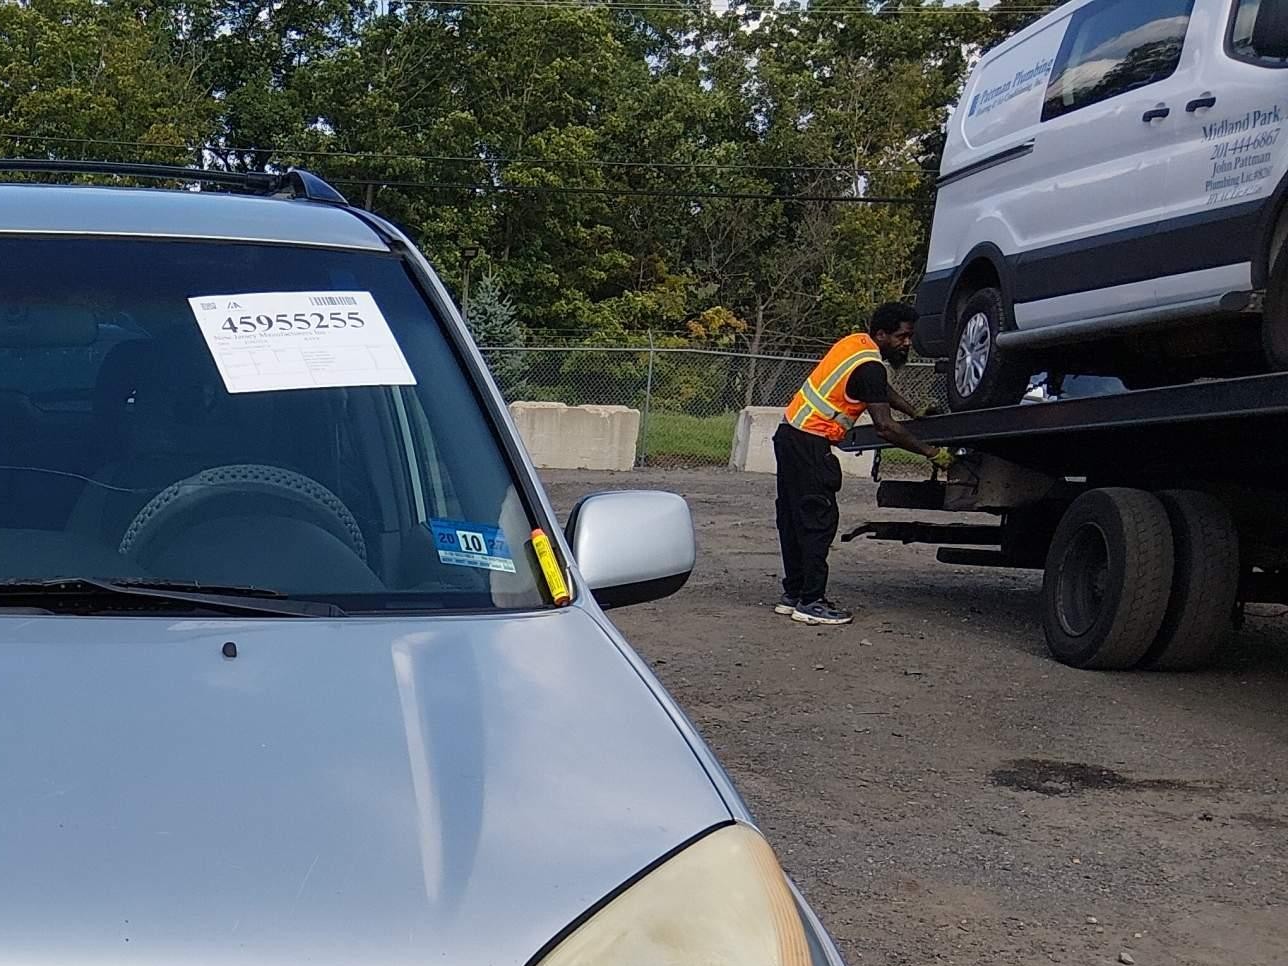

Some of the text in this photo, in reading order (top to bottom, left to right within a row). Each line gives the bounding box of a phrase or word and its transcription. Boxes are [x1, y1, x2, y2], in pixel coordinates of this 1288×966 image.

[1201, 112, 1250, 141] Midland
[1212, 159, 1232, 179] John
[1233, 151, 1272, 170] Pattman
[221, 311, 365, 333] 45955255
[438, 532, 505, 552] 20 10 27
